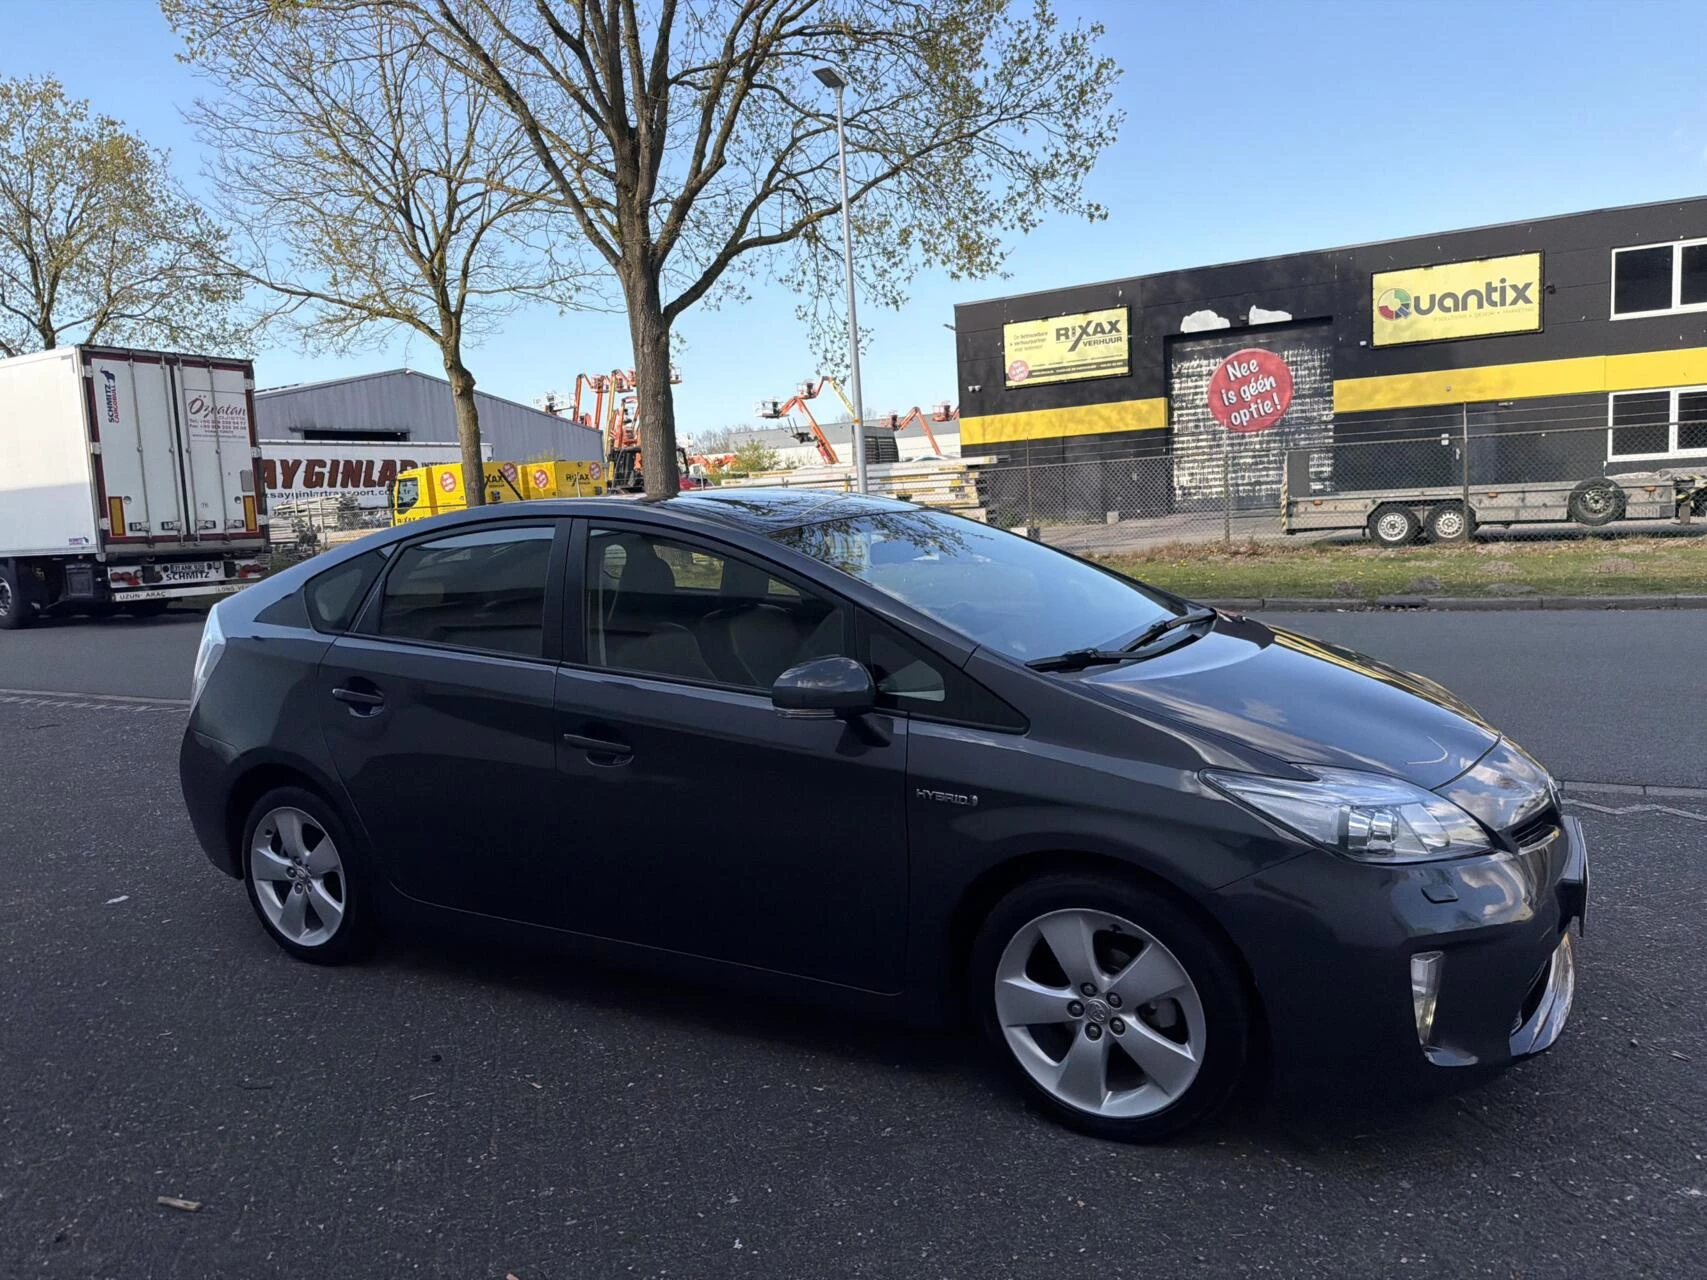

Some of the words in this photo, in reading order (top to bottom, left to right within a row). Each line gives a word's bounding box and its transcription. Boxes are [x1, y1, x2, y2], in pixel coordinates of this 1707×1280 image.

[1377, 277, 1534, 321] Quantix
[1083, 336, 1122, 348] VERHUUR
[1226, 359, 1259, 381] Nee
[105, 383, 114, 423] SCHMITZ
[111, 384, 119, 424] CARGOBULL
[1221, 389, 1237, 406] is
[1240, 374, 1276, 401] géén
[1231, 392, 1281, 427] optie!
[166, 571, 210, 581] SCHMITZ
[916, 788, 968, 805] HYBRID
